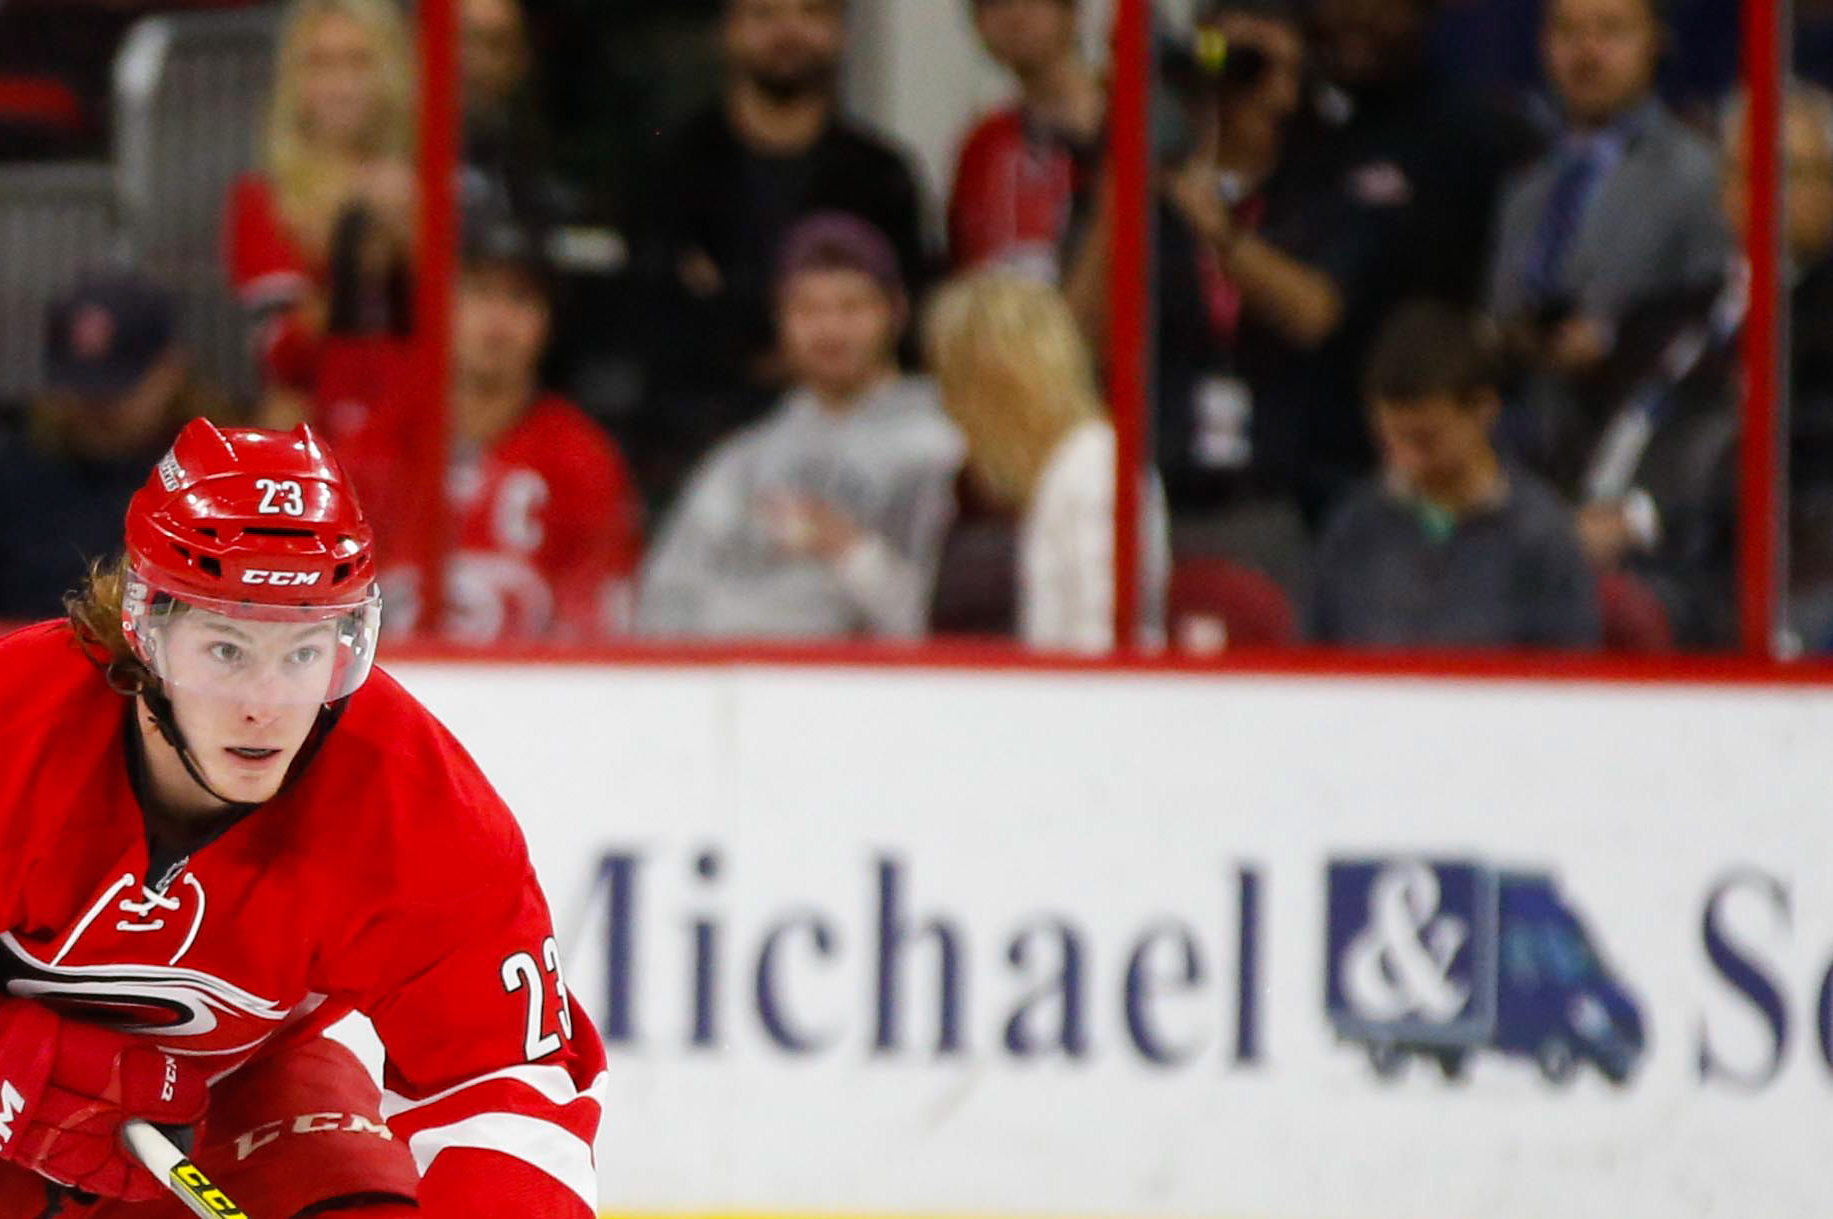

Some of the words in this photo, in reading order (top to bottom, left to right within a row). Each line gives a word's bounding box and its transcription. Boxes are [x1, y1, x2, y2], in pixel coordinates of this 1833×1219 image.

[255, 479, 304, 516] 23
[241, 568, 321, 586] CCM
[500, 935, 573, 1062] 23
[1693, 862, 1833, 1090] S
[233, 1111, 394, 1161] CCM
